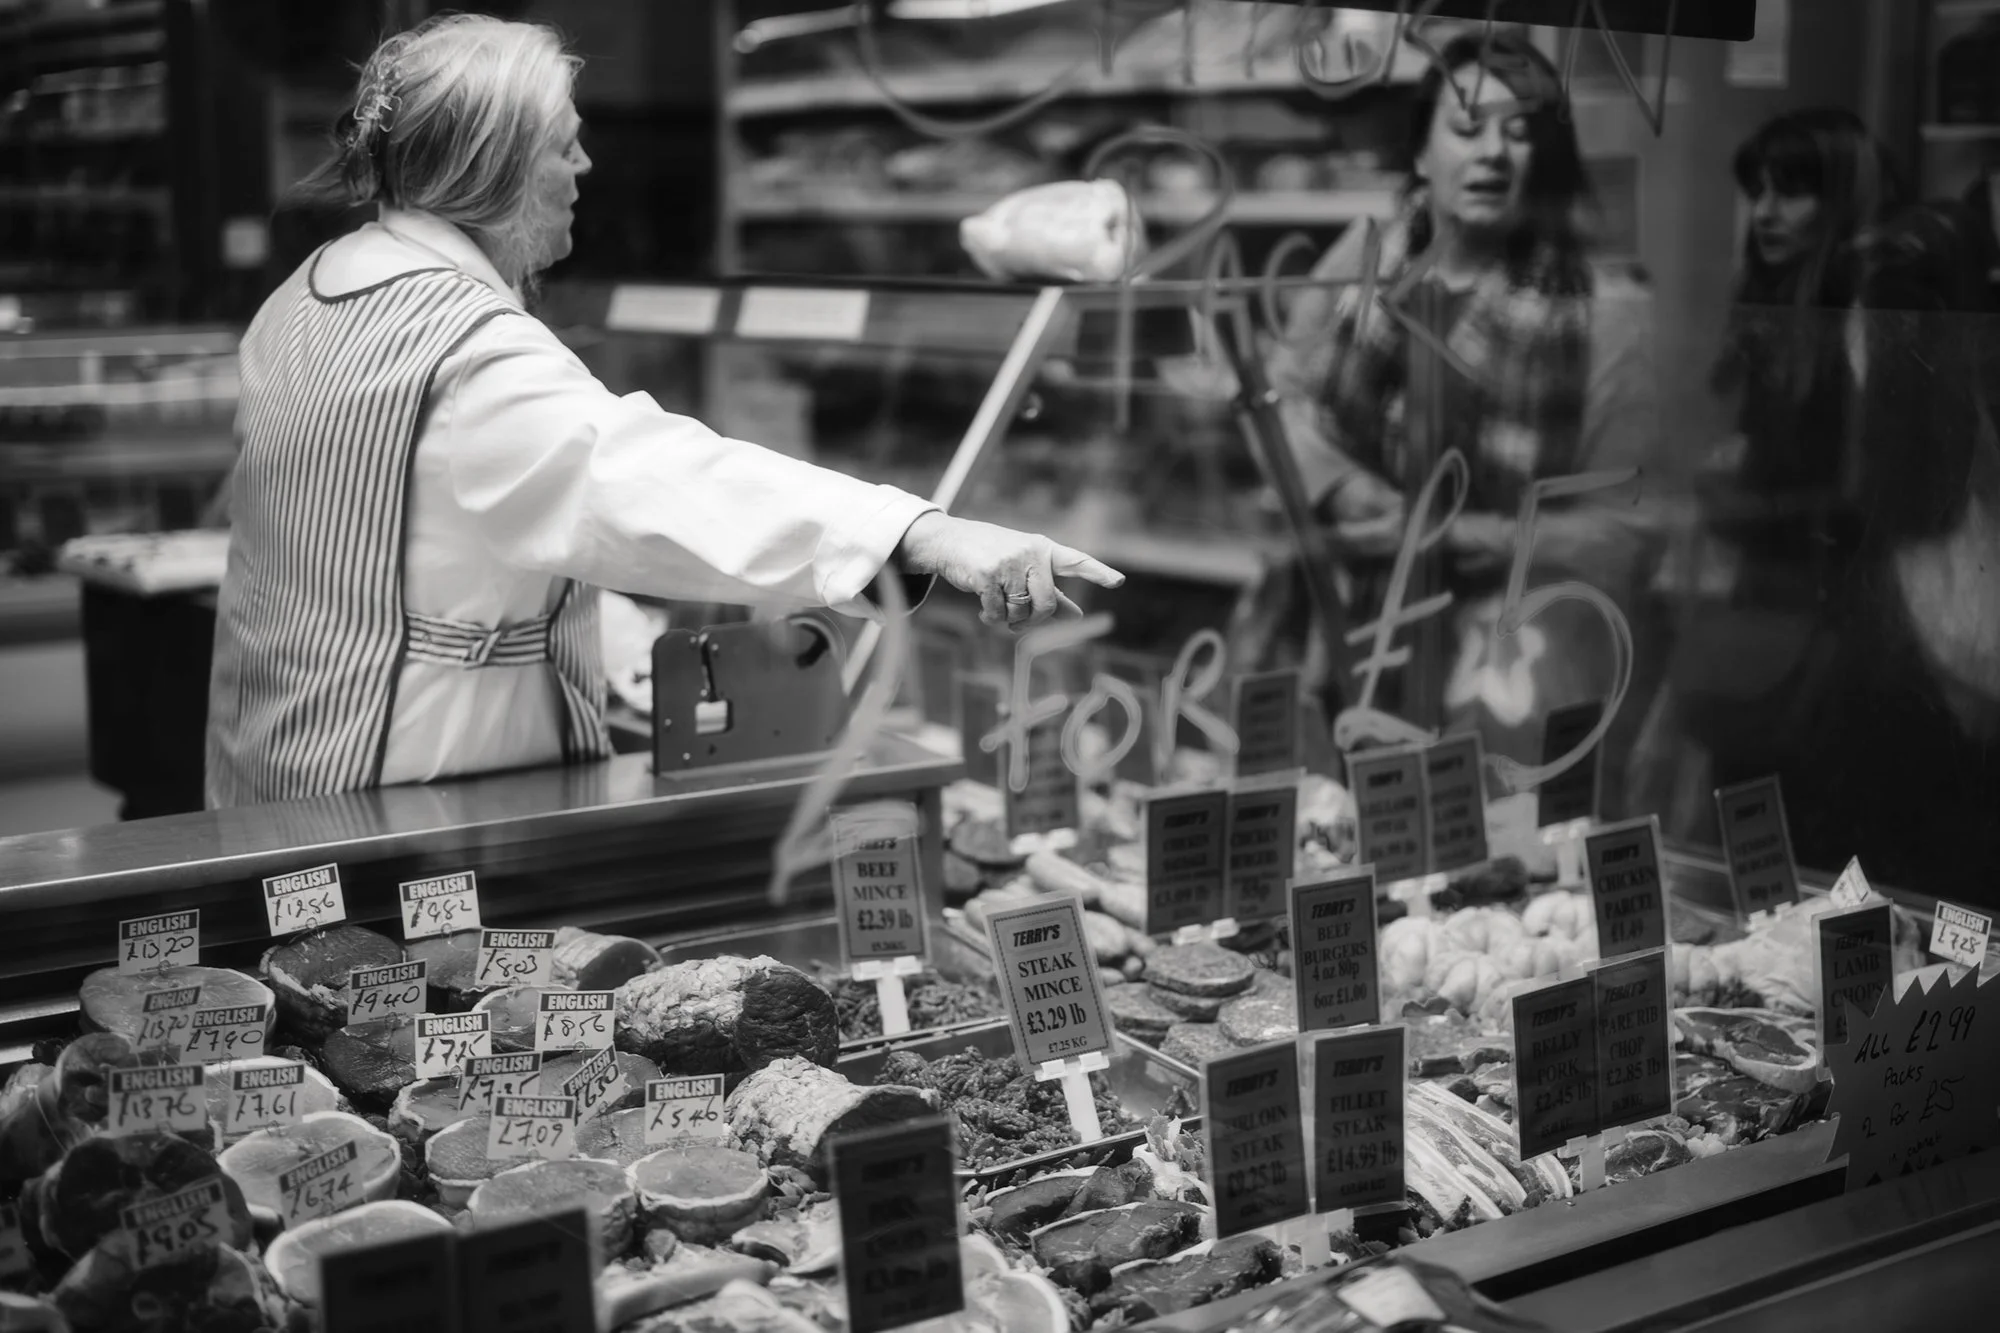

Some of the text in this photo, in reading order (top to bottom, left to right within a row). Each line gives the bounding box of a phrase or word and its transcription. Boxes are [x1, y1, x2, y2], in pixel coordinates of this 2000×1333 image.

[981, 614, 1239, 791] FOR
[1334, 447, 1641, 791] £5
[857, 861, 898, 878] BEEF
[272, 868, 331, 896] ENGLISH
[408, 875, 468, 900] ENGLISH
[853, 885, 908, 901] MINCE
[128, 915, 191, 938] ENGLISH
[898, 908, 914, 930] lb
[1941, 906, 1985, 933] ENGLISH
[489, 932, 547, 948] ENGLISH
[1013, 924, 1060, 948] TERRY'S
[1316, 923, 1352, 942] BEEF
[1018, 951, 1077, 978] STEAK
[1303, 941, 1368, 966] BURGERS
[1833, 952, 1880, 979] LAMB
[359, 964, 419, 988] ENGLISH
[1023, 976, 1083, 1002] MINCE
[548, 993, 608, 1010] ENGLISH
[194, 1007, 259, 1027] ENGLISH
[424, 1014, 483, 1036] ENGLISH
[1026, 1003, 1086, 1035] £3.29 lb
[1637, 1006, 1659, 1026] RIB
[1533, 1029, 1583, 1060] BELLY
[1609, 1036, 1646, 1062] CHOP
[1855, 1032, 1891, 1064] ALL
[473, 1055, 533, 1075] ENGLISH
[569, 1050, 611, 1095] ENGLISH
[1537, 1058, 1580, 1087] PORK
[1606, 1056, 1661, 1088] £2.85 lb
[120, 1068, 195, 1090] ENGLISH
[240, 1067, 299, 1089] ENGLISH
[655, 1080, 715, 1100] ENGLISH
[1330, 1090, 1388, 1113] FILLET
[1577, 1081, 1592, 1102] lb
[503, 1099, 567, 1117] ENGLISH
[1861, 1116, 1877, 1139] 2
[1918, 1075, 1966, 1123] £5
[1332, 1115, 1387, 1138] STEAK
[1230, 1134, 1285, 1163] STEAK
[1326, 1140, 1397, 1174] £14.99 lb
[285, 1147, 350, 1188] ENGLISH
